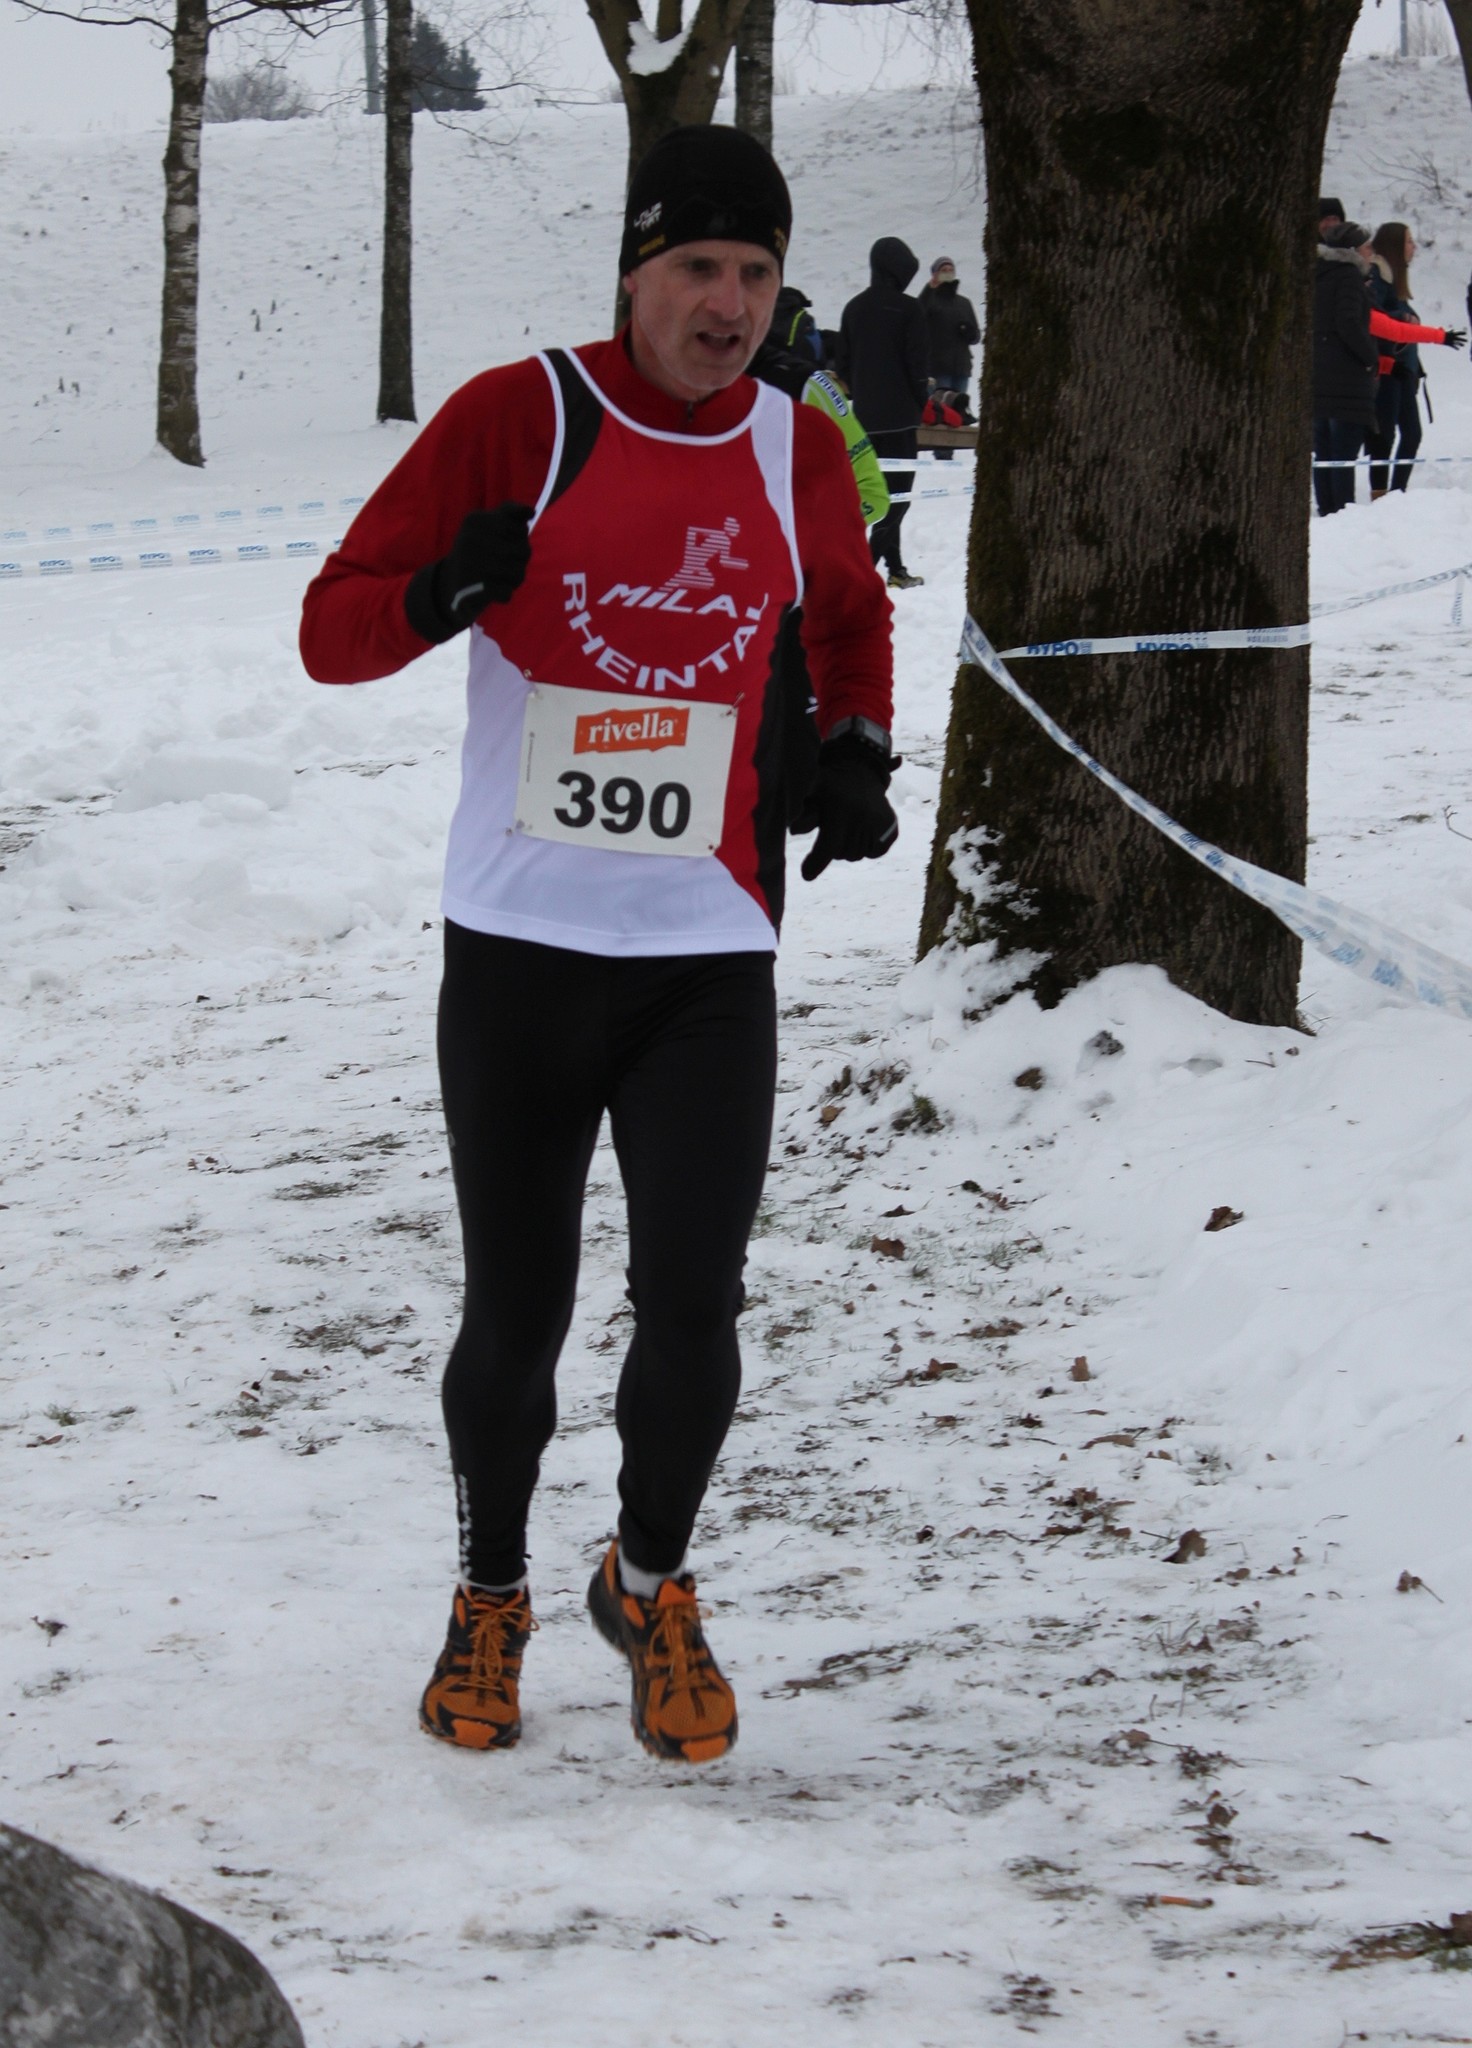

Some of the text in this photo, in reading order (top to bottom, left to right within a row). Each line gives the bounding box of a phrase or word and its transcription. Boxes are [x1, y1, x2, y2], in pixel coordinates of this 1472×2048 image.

[563, 572, 769, 692] RHEINTAL
[588, 712, 674, 744] rivella
[554, 769, 692, 839] 390
